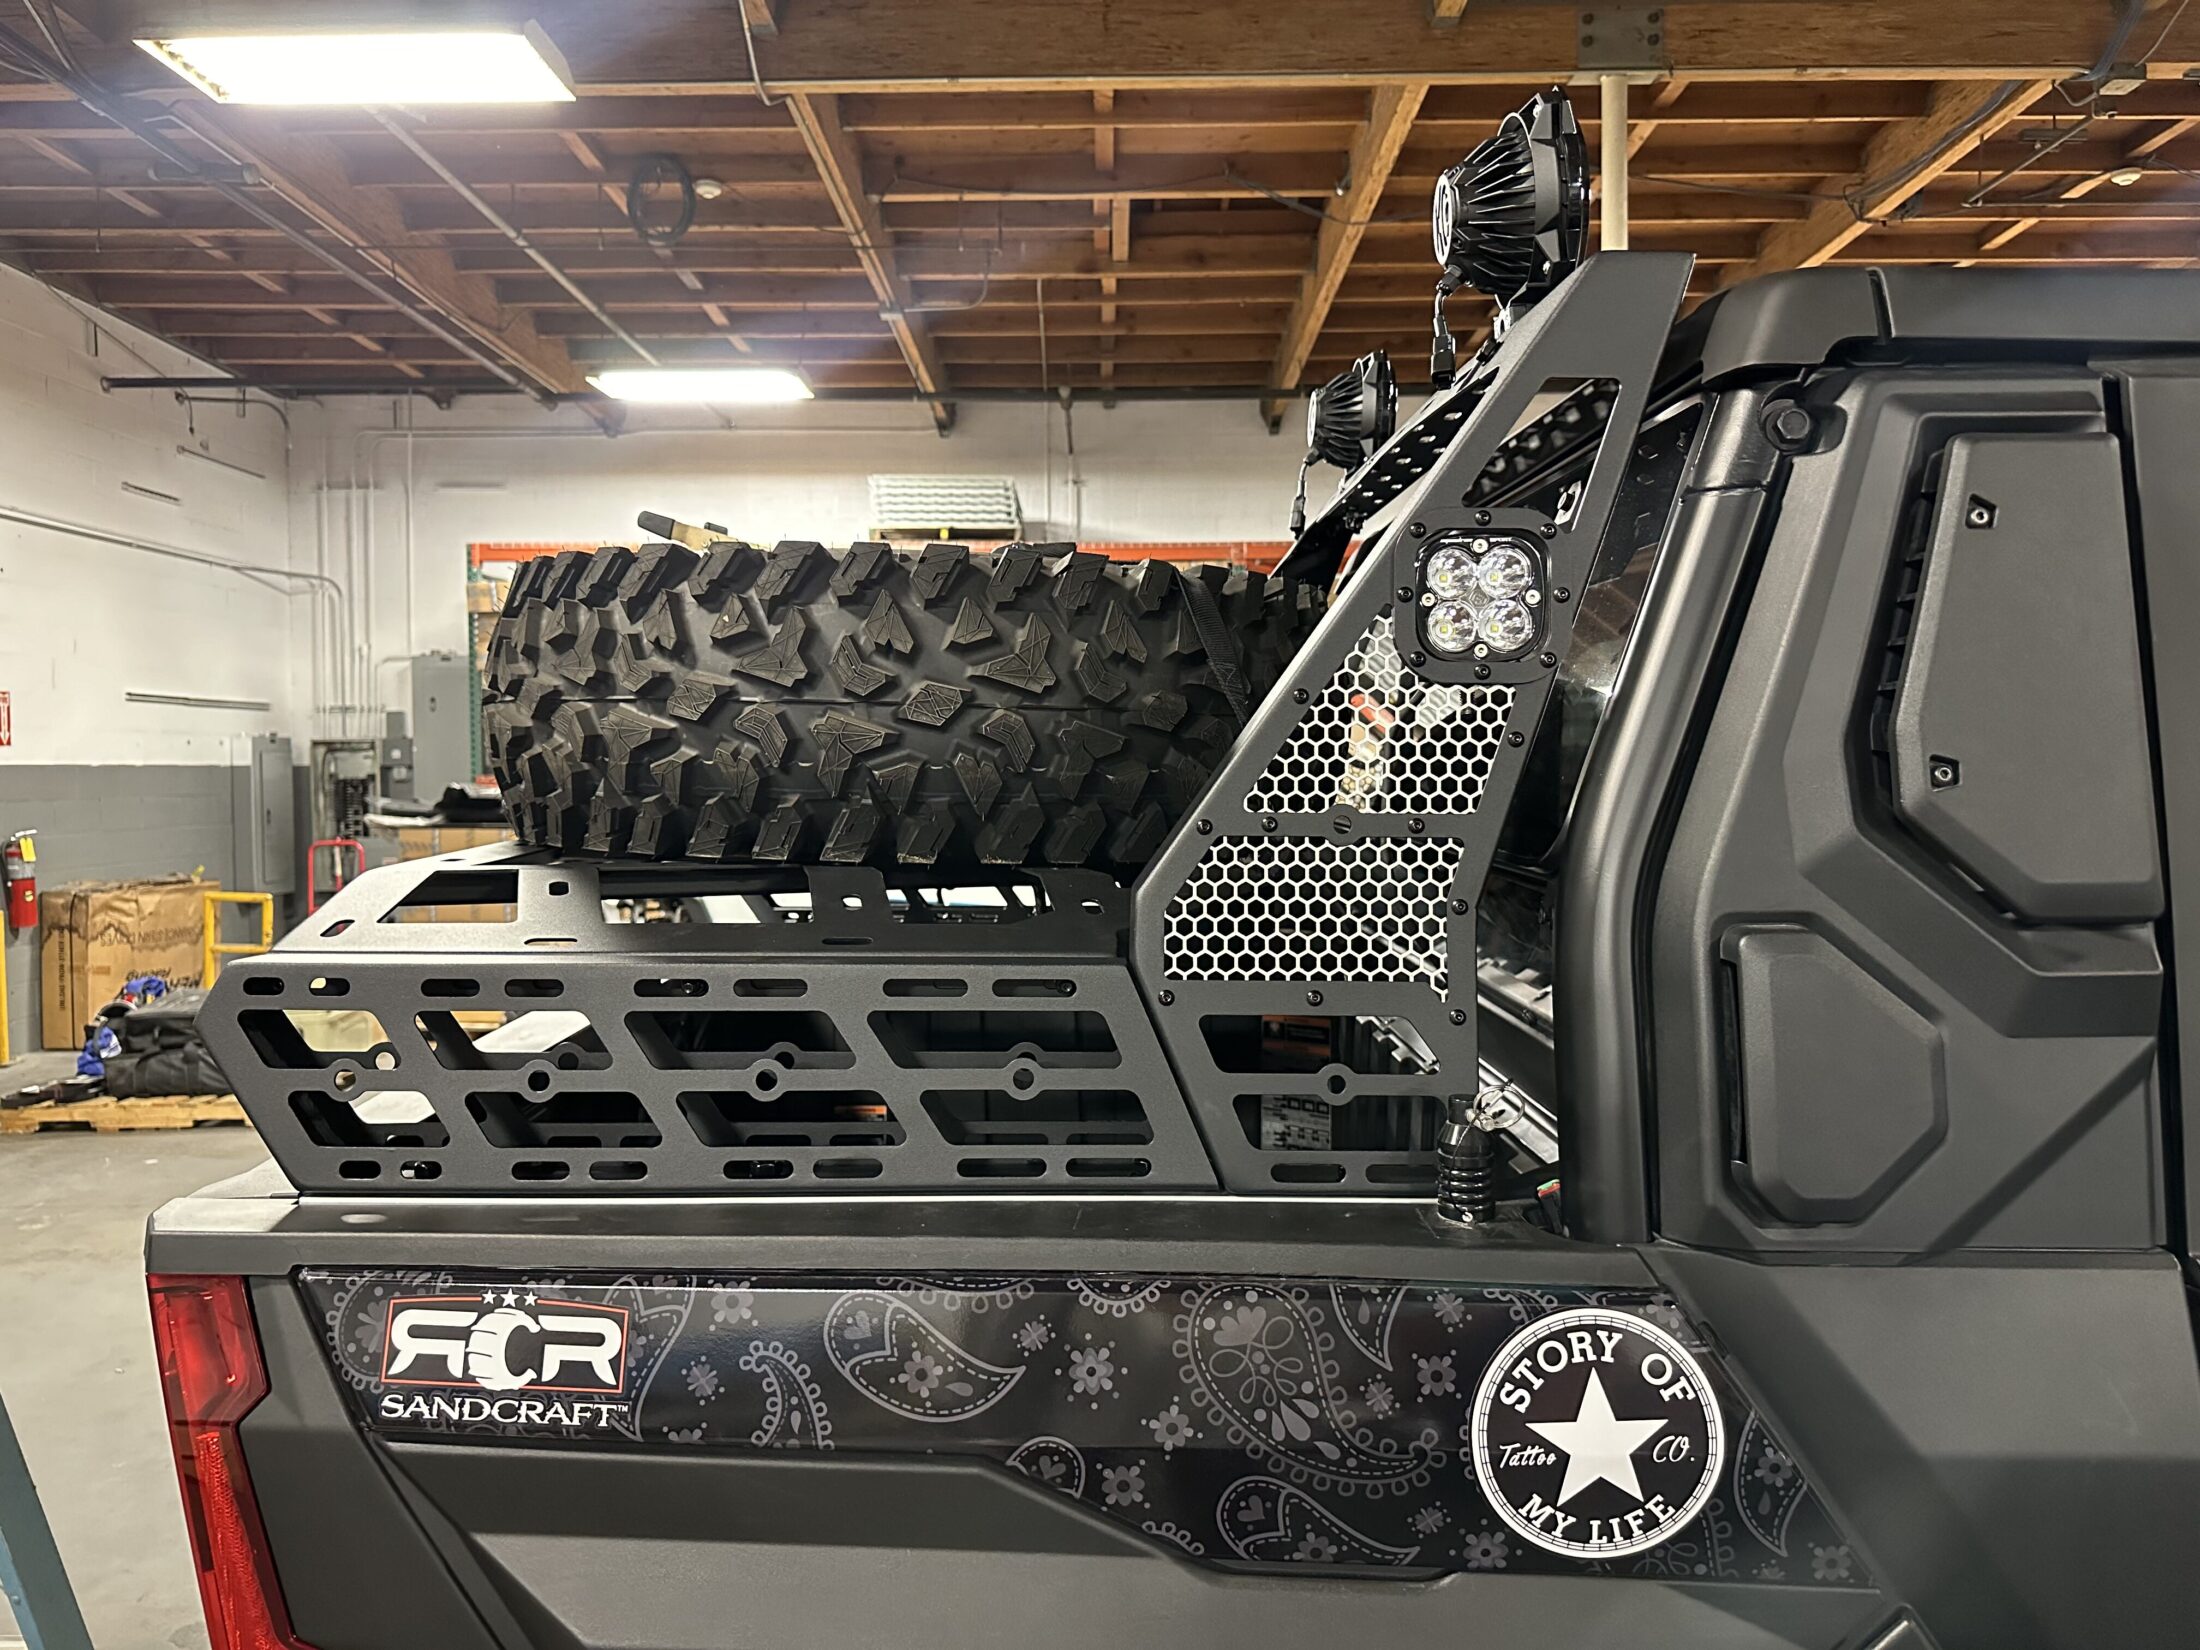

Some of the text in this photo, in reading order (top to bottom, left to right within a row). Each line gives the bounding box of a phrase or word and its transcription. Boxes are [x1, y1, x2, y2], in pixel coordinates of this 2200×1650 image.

[1500, 1330, 1696, 1413] STORY OF
[1500, 1443, 1557, 1468] Tattoo
[1518, 1494, 1676, 1544] MY LIFE
